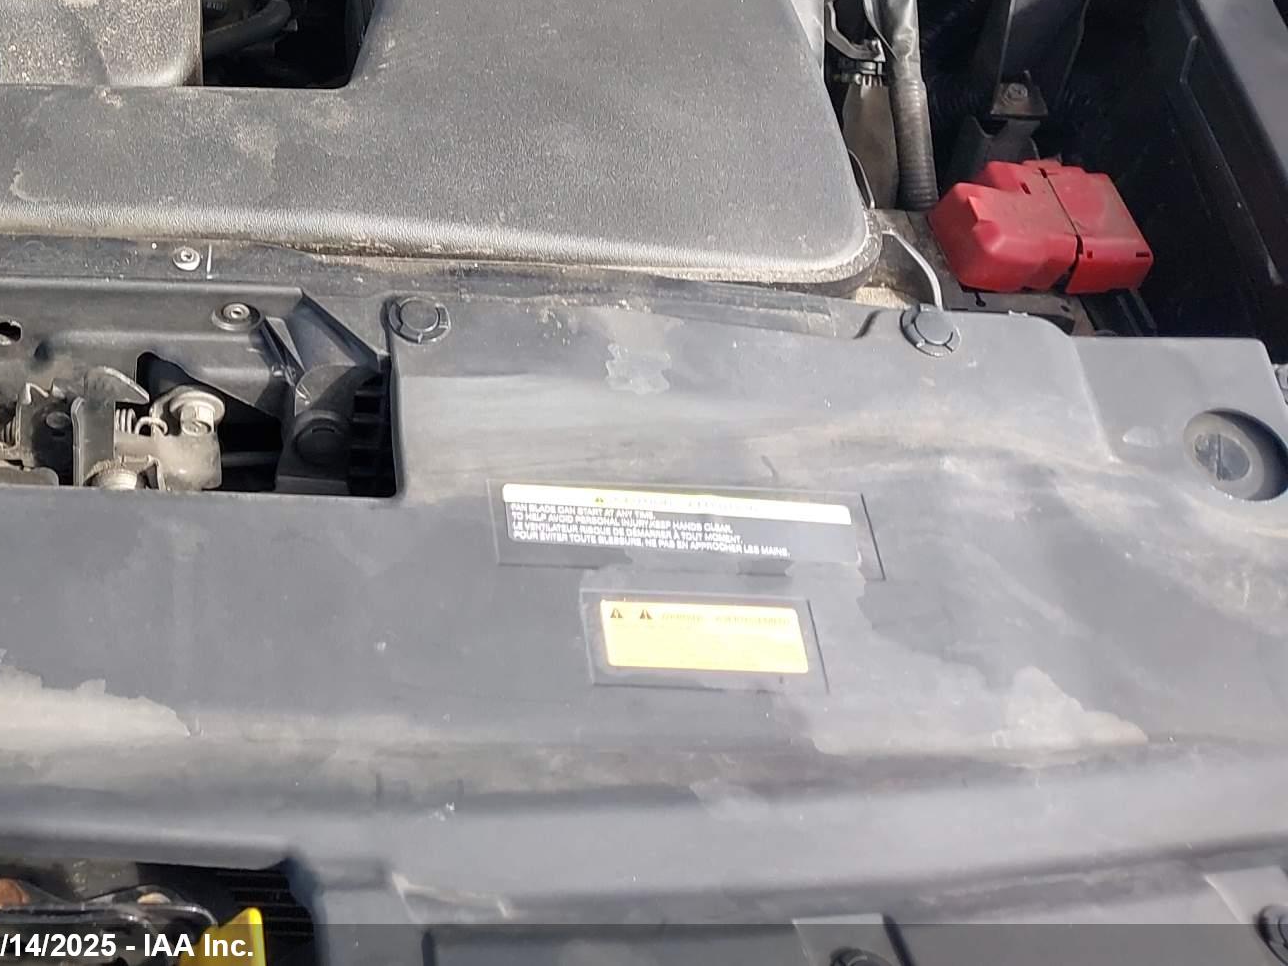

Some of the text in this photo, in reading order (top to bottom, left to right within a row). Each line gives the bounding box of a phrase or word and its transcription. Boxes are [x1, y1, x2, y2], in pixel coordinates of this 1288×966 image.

[577, 506, 603, 516] START
[512, 512, 523, 521] TO
[526, 513, 547, 522] HELP
[548, 514, 573, 523] AVOID
[575, 515, 620, 526] PERSONAL
[672, 522, 702, 532] HANDS
[513, 531, 539, 540] POUR
[569, 533, 596, 544] TOUTE
[645, 538, 657, 548] NE
[658, 539, 675, 549] PAS
[677, 540, 689, 550] EN
[690, 541, 743, 554] APPROCHER
[613, 527, 624, 536] DE
[680, 532, 703, 541] TOUT
